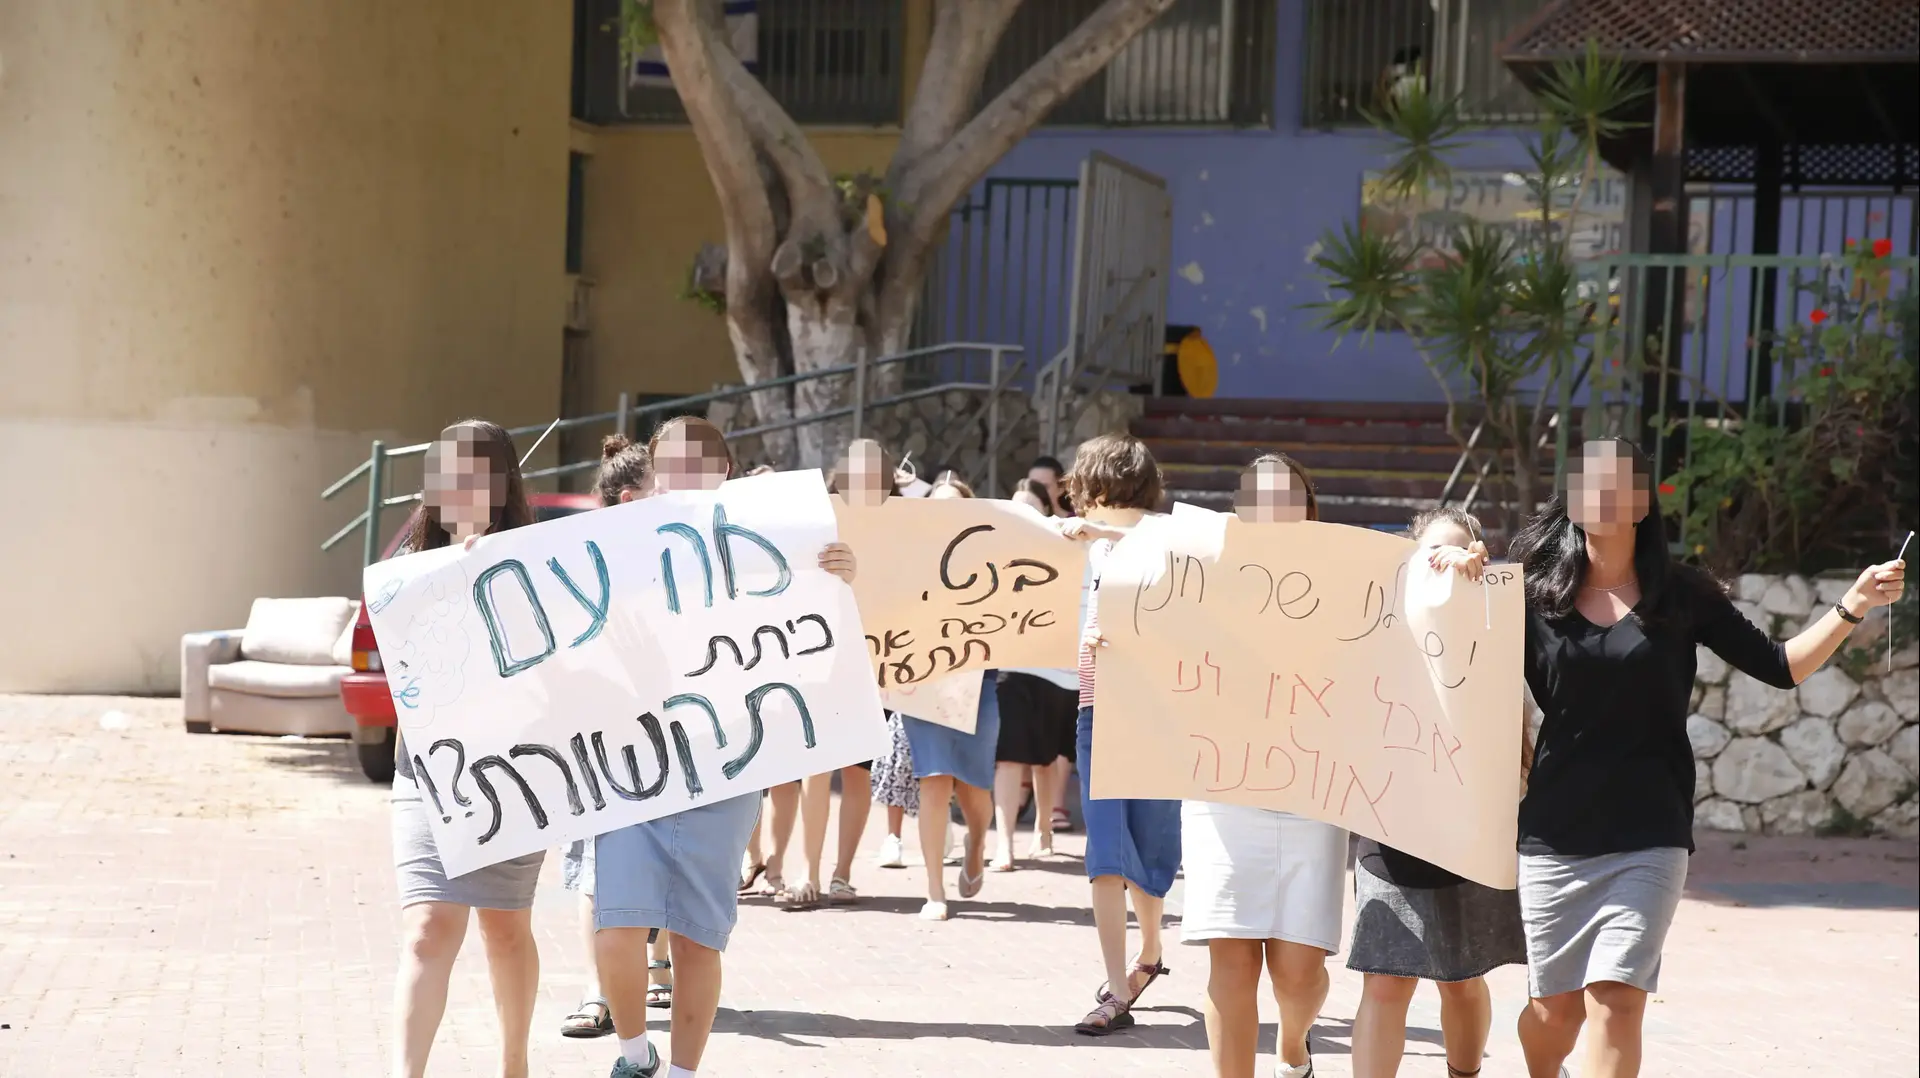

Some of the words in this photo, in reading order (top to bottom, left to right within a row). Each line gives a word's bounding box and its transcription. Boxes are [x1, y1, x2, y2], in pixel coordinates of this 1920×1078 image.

[655, 502, 794, 614] מה
[1240, 564, 1319, 619] שר
[473, 540, 611, 678] עם
[941, 609, 1056, 638] איפה
[1335, 562, 1407, 641] לנו
[684, 613, 835, 677] כיתת
[1171, 651, 1221, 696] לנו
[1265, 672, 1335, 719] אין
[1374, 676, 1464, 786] אבל
[414, 682, 817, 845] תקשורת?!
[1189, 725, 1393, 837] אולפנה
